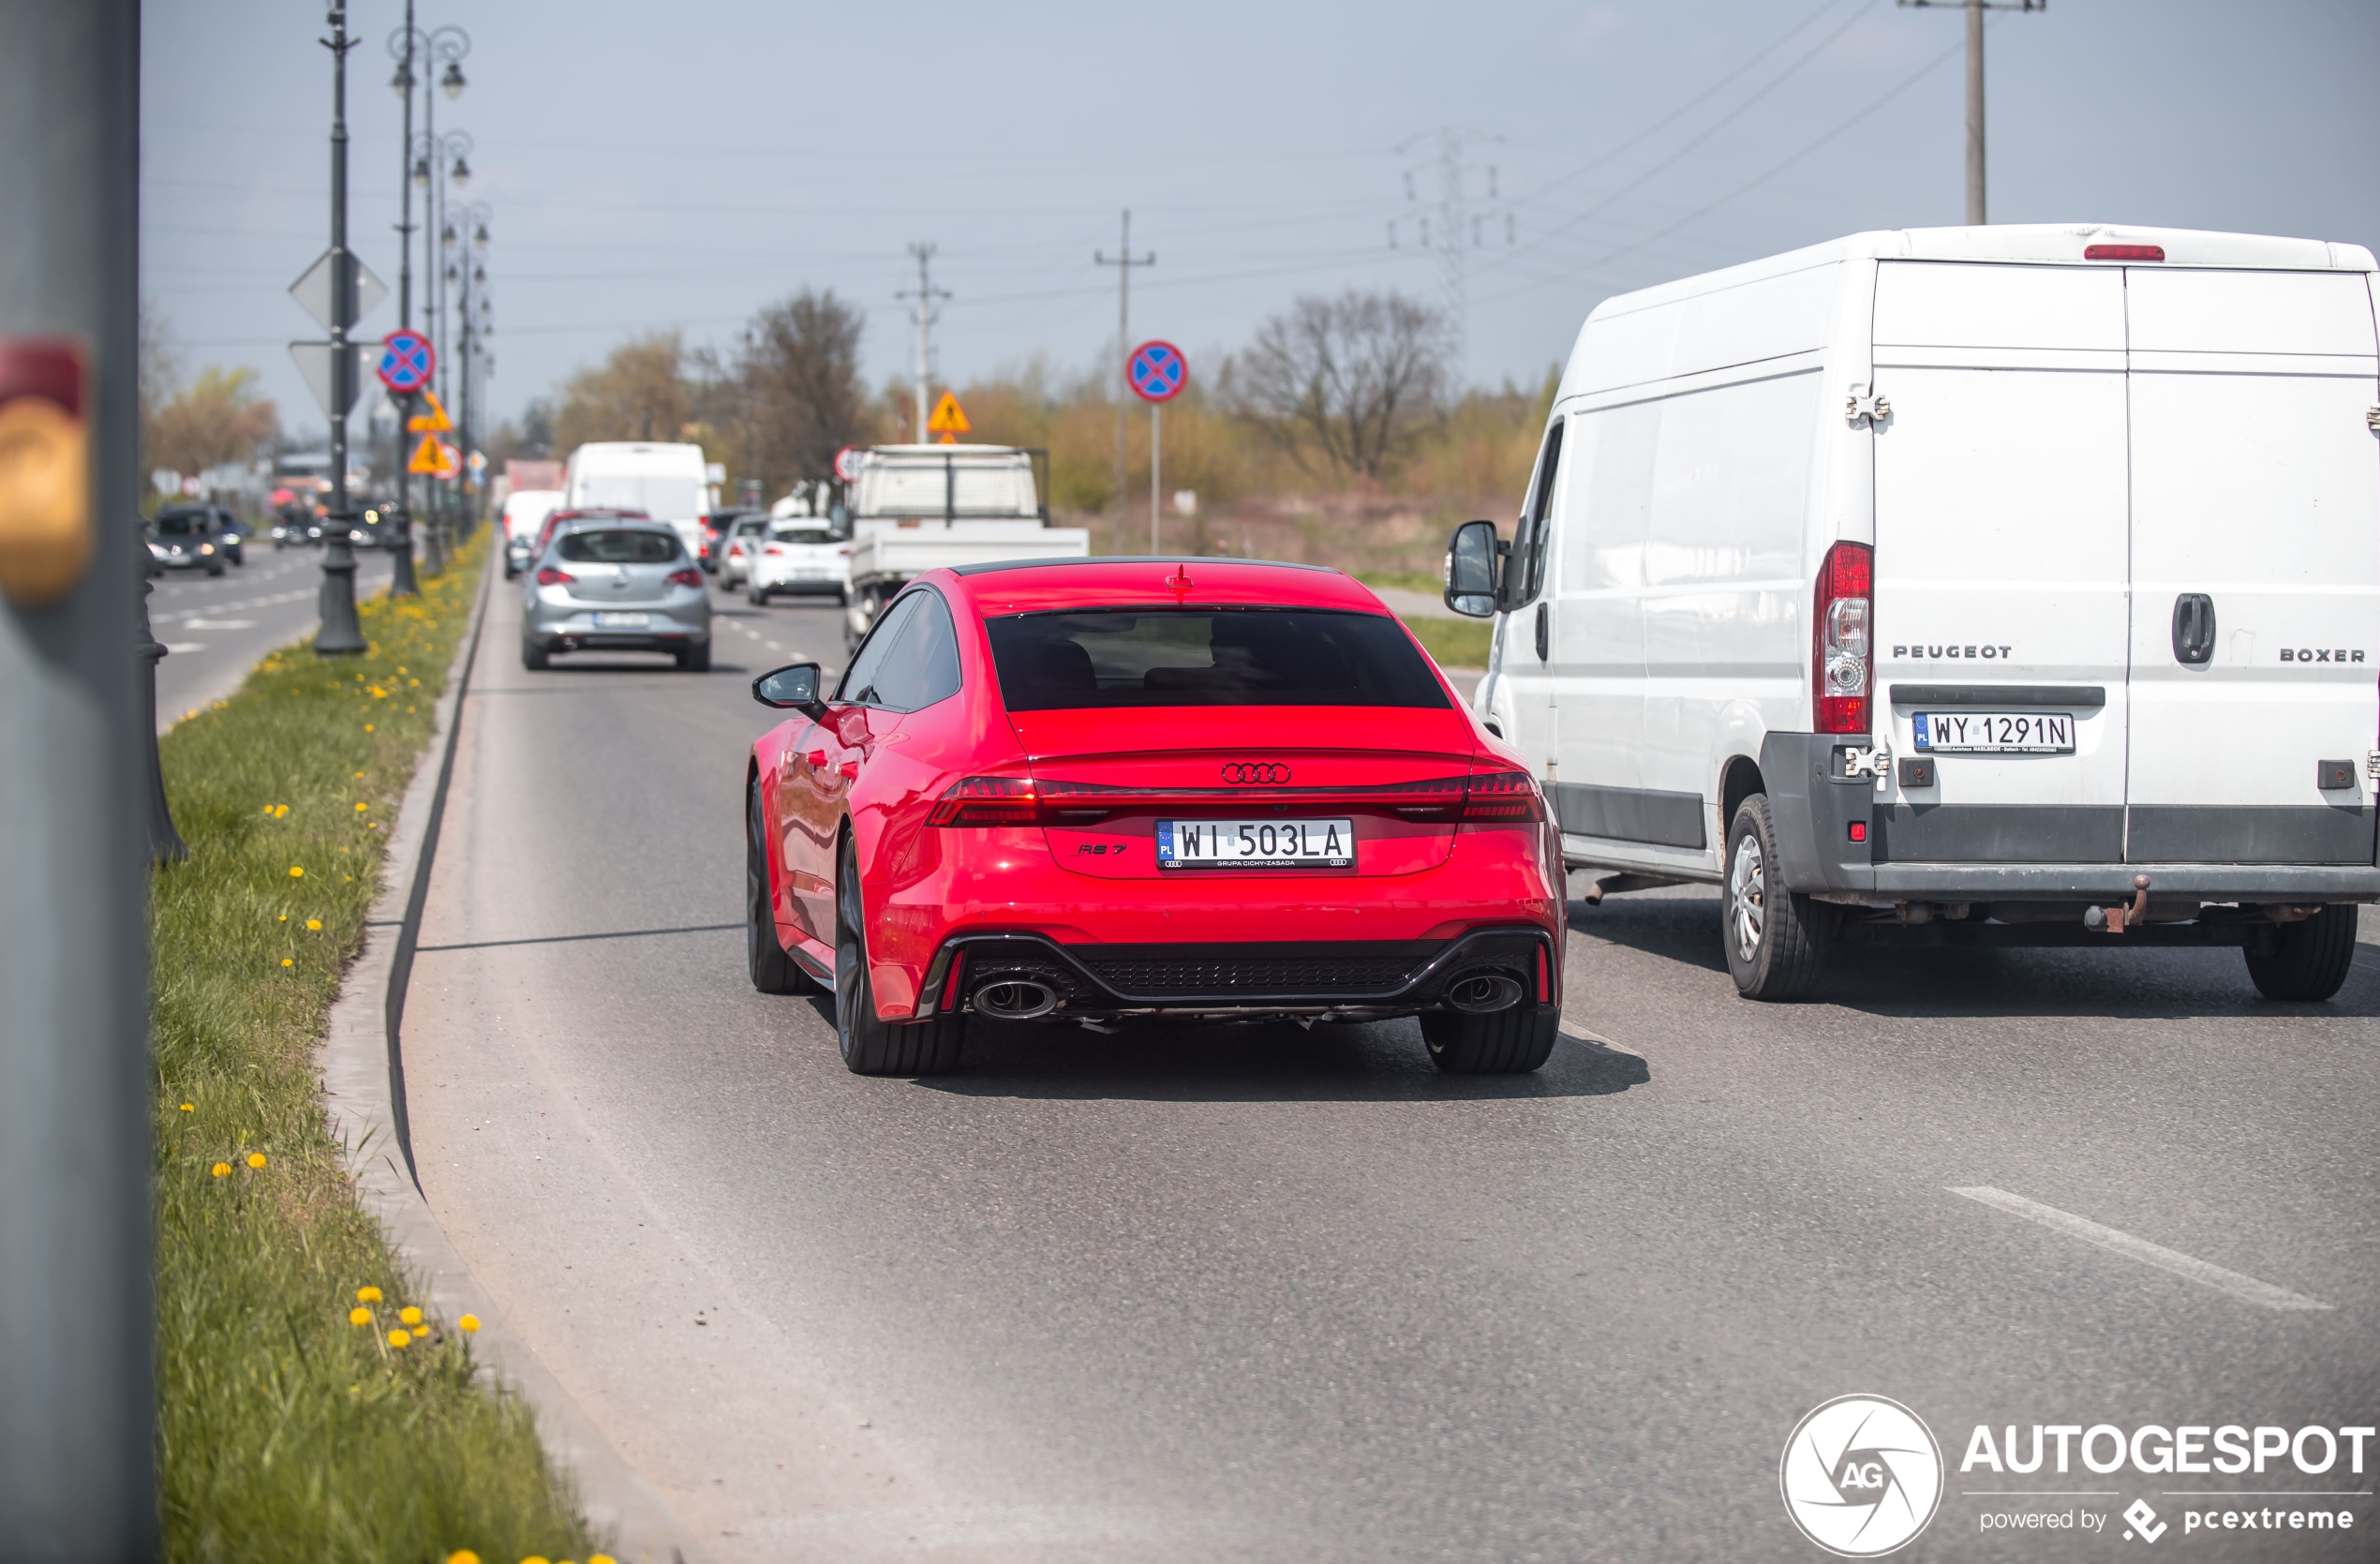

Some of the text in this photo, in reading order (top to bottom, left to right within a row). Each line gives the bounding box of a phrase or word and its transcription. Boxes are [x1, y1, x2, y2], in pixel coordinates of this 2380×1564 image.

[1892, 645, 2012, 659] PEUGEOT
[2280, 648, 2365, 663] BOXER
[1934, 717, 2066, 744] WY 1291N
[1181, 824, 1343, 857] WI 503LA
[1160, 845, 1172, 855] PL
